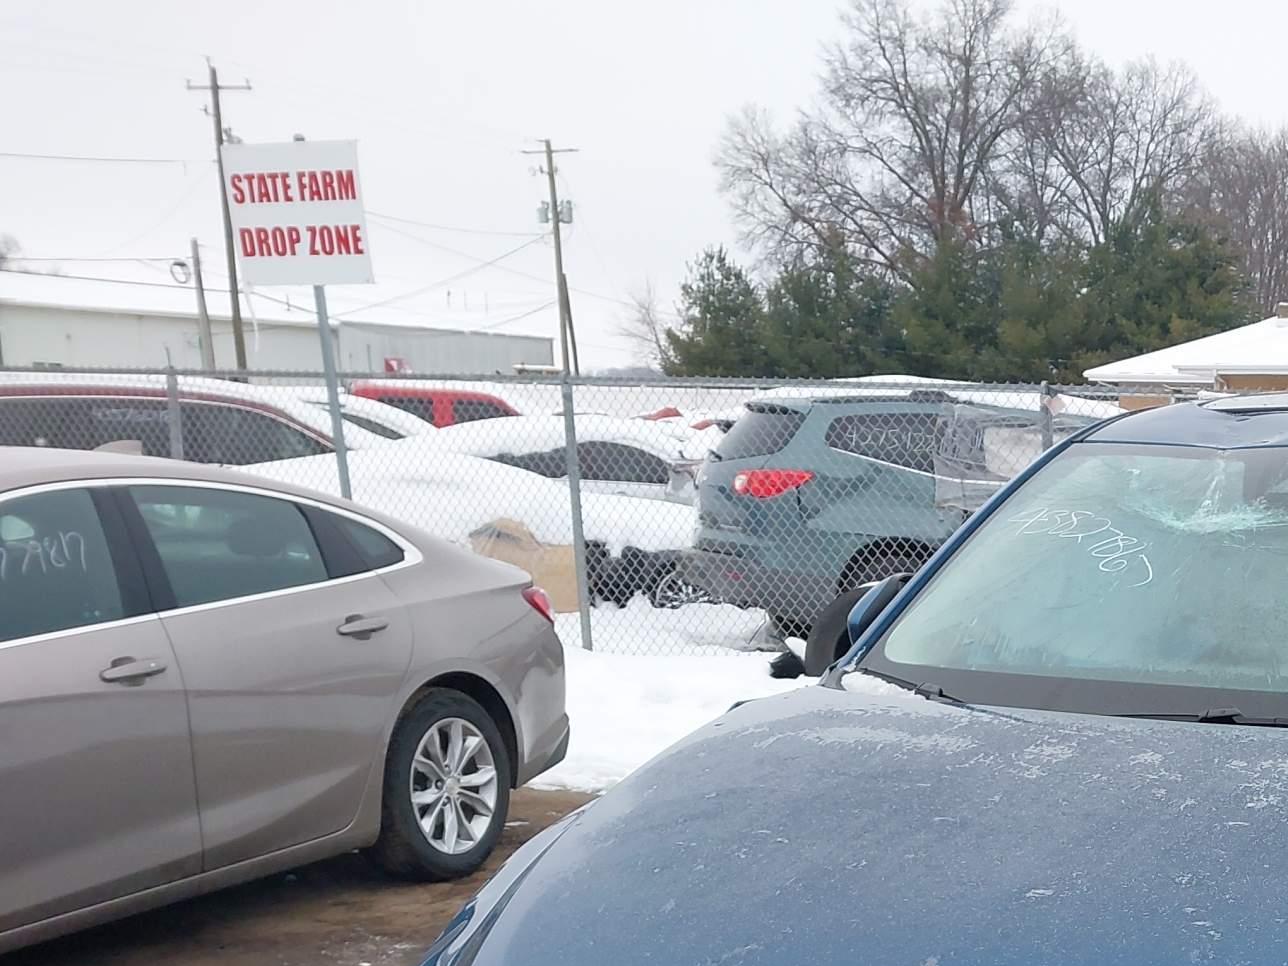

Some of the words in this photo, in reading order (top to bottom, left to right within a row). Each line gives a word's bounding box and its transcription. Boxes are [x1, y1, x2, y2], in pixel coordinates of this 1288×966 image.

[230, 171, 294, 204] STATE
[296, 169, 357, 201] FARM
[239, 226, 301, 257] DROP
[306, 224, 364, 256] ZONE
